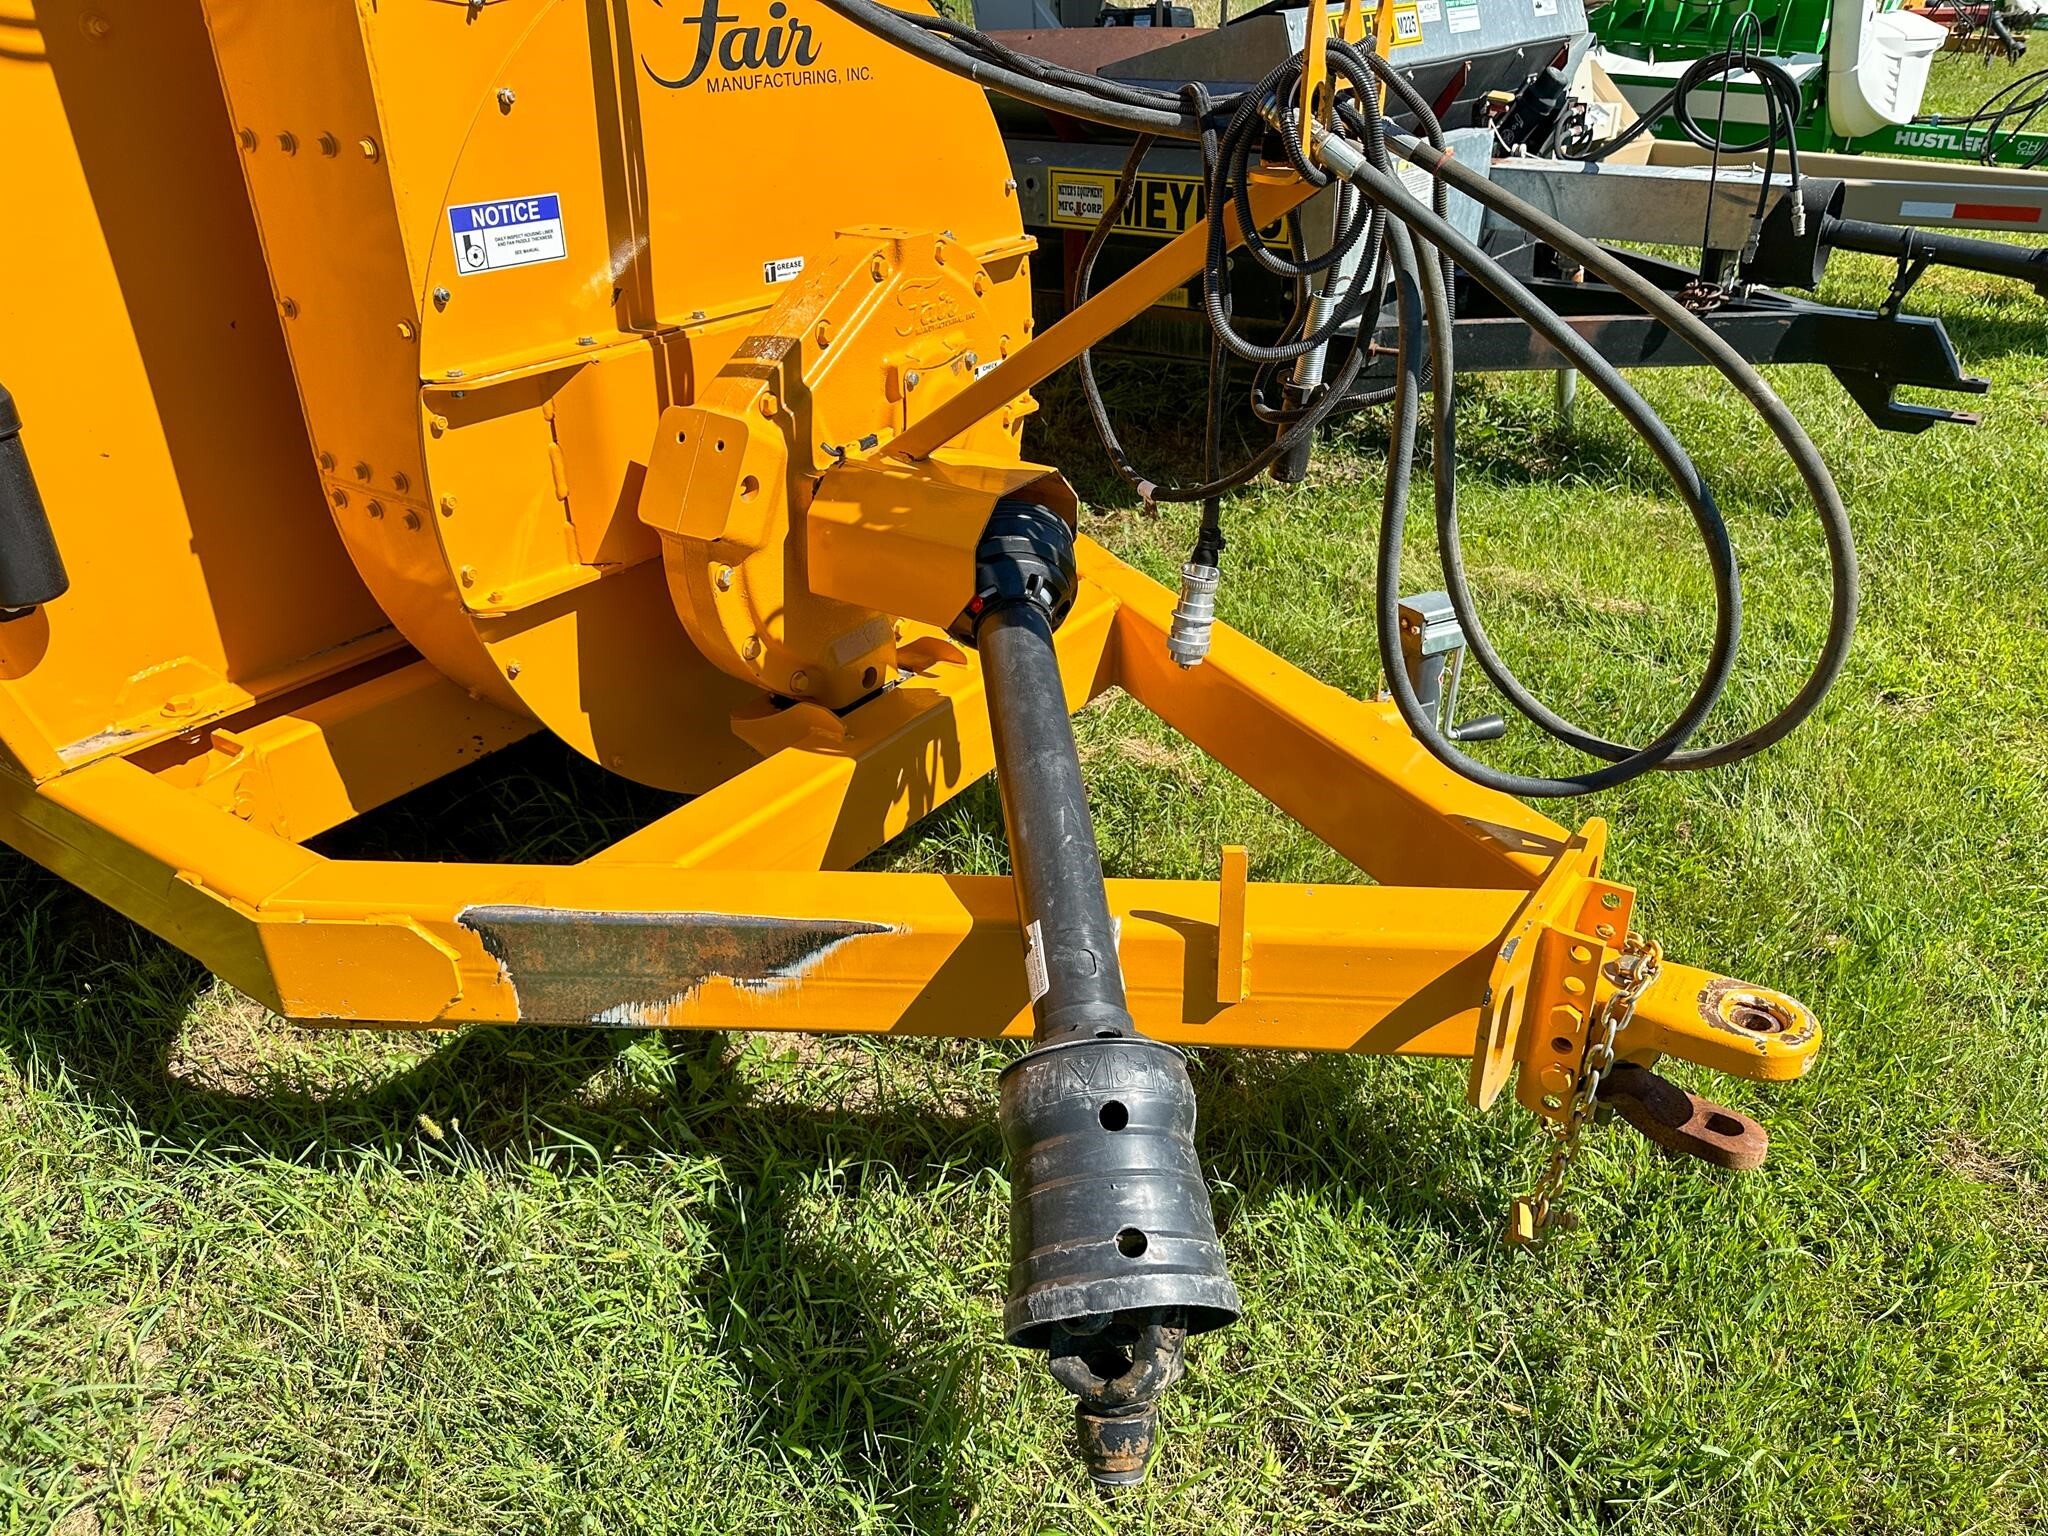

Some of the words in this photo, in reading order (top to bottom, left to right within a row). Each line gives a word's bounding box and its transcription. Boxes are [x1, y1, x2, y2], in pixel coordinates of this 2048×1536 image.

[1396, 15, 1417, 34] M225
[641, 0, 822, 89] Fair
[706, 70, 842, 93] MANUFACTURING,
[846, 66, 874, 82] INC.
[1894, 130, 1988, 152] HUSTLER
[470, 200, 541, 228] NOTICE
[1058, 200, 1076, 212] MFG.
[1081, 202, 1103, 214] CORP.
[776, 260, 802, 271] GREASE
